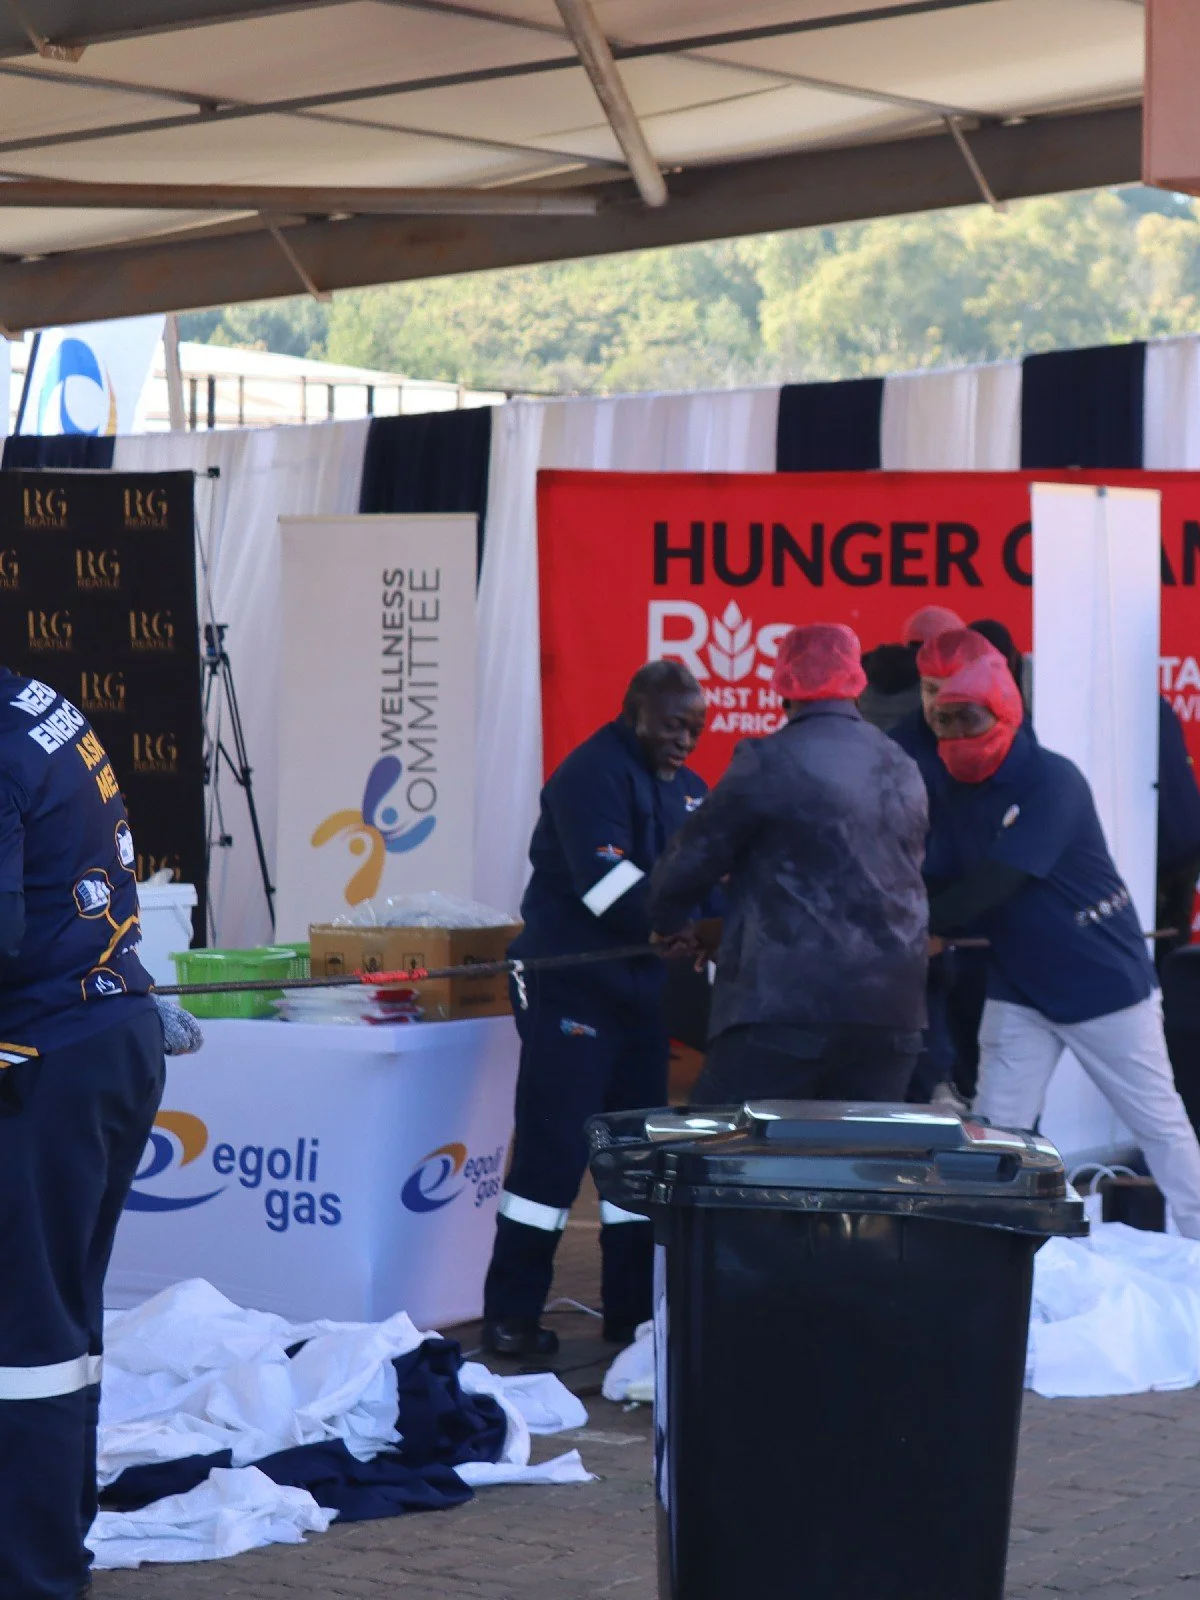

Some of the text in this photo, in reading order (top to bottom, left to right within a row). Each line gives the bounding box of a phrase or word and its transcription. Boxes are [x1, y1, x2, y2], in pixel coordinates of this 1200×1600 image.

[23, 487, 68, 516] RG
[123, 488, 168, 516] RG
[75, 549, 121, 577] RG
[653, 521, 983, 587] HUNGER
[28, 610, 73, 638] RG
[130, 611, 174, 638] RG
[381, 568, 404, 753] WELLNESS
[81, 671, 126, 700] RG
[28, 698, 86, 755] ENERG
[133, 733, 178, 761] RG
[212, 1137, 320, 1189] egoli
[464, 1146, 504, 1185] egoli
[475, 1177, 501, 1209] gas
[265, 1188, 342, 1233] gas
